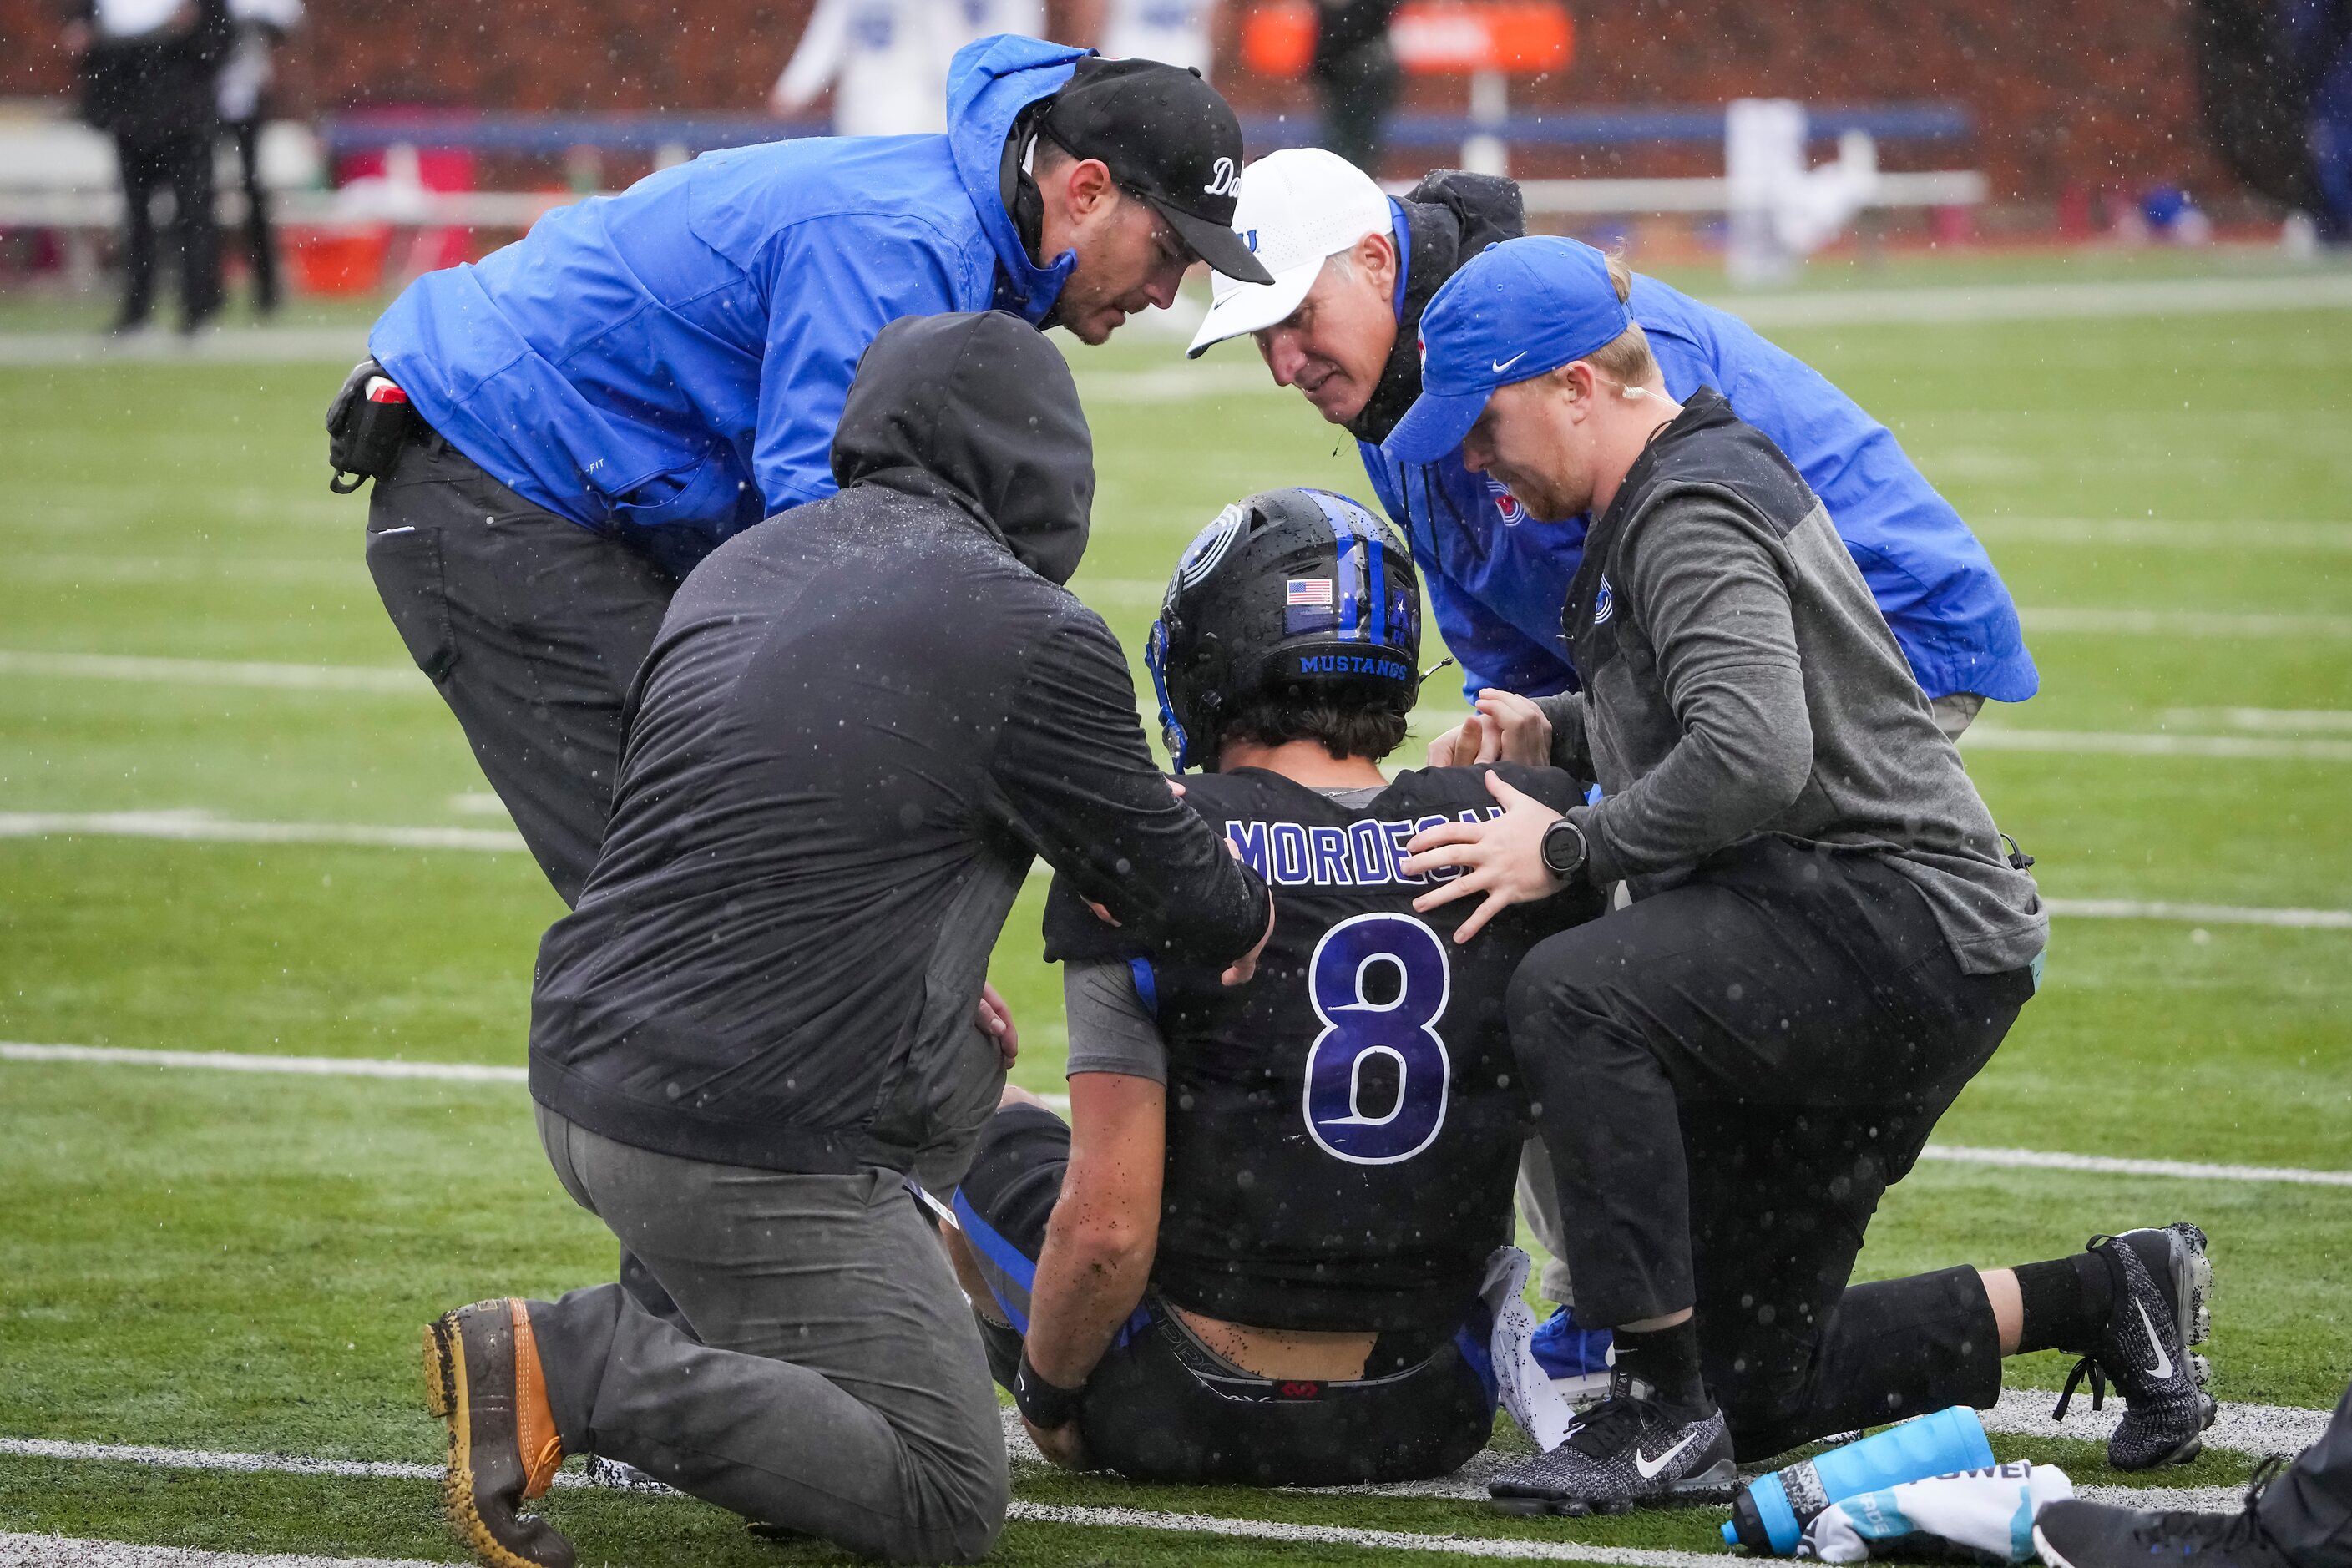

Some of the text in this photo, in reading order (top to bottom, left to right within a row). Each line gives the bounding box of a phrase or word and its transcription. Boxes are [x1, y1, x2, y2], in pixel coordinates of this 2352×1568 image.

[1300, 655, 1408, 682] MUSTANGS
[1225, 805, 1504, 886] MORDE
[1302, 912, 1450, 1165] 8
